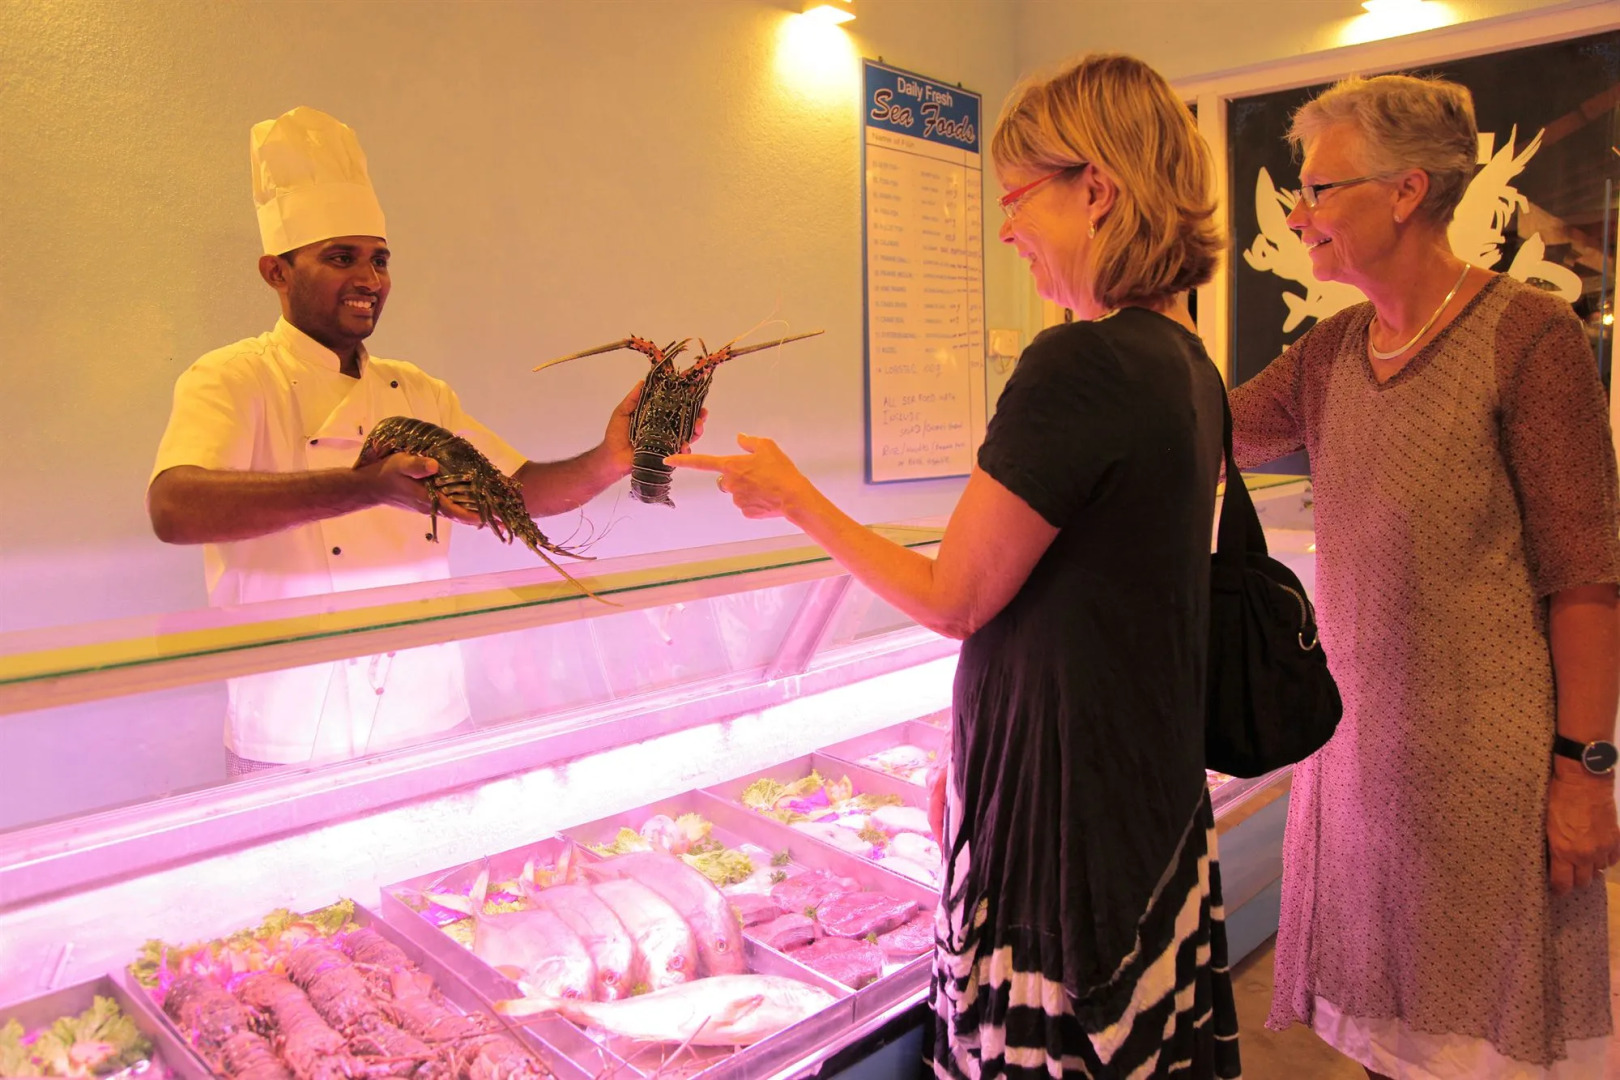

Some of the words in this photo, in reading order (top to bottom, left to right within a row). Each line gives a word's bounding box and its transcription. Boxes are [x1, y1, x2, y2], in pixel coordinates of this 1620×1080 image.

[897, 77, 923, 102] Daily
[925, 85, 953, 108] Fresh
[870, 88, 914, 128] Sea
[920, 102, 976, 144] Foods
